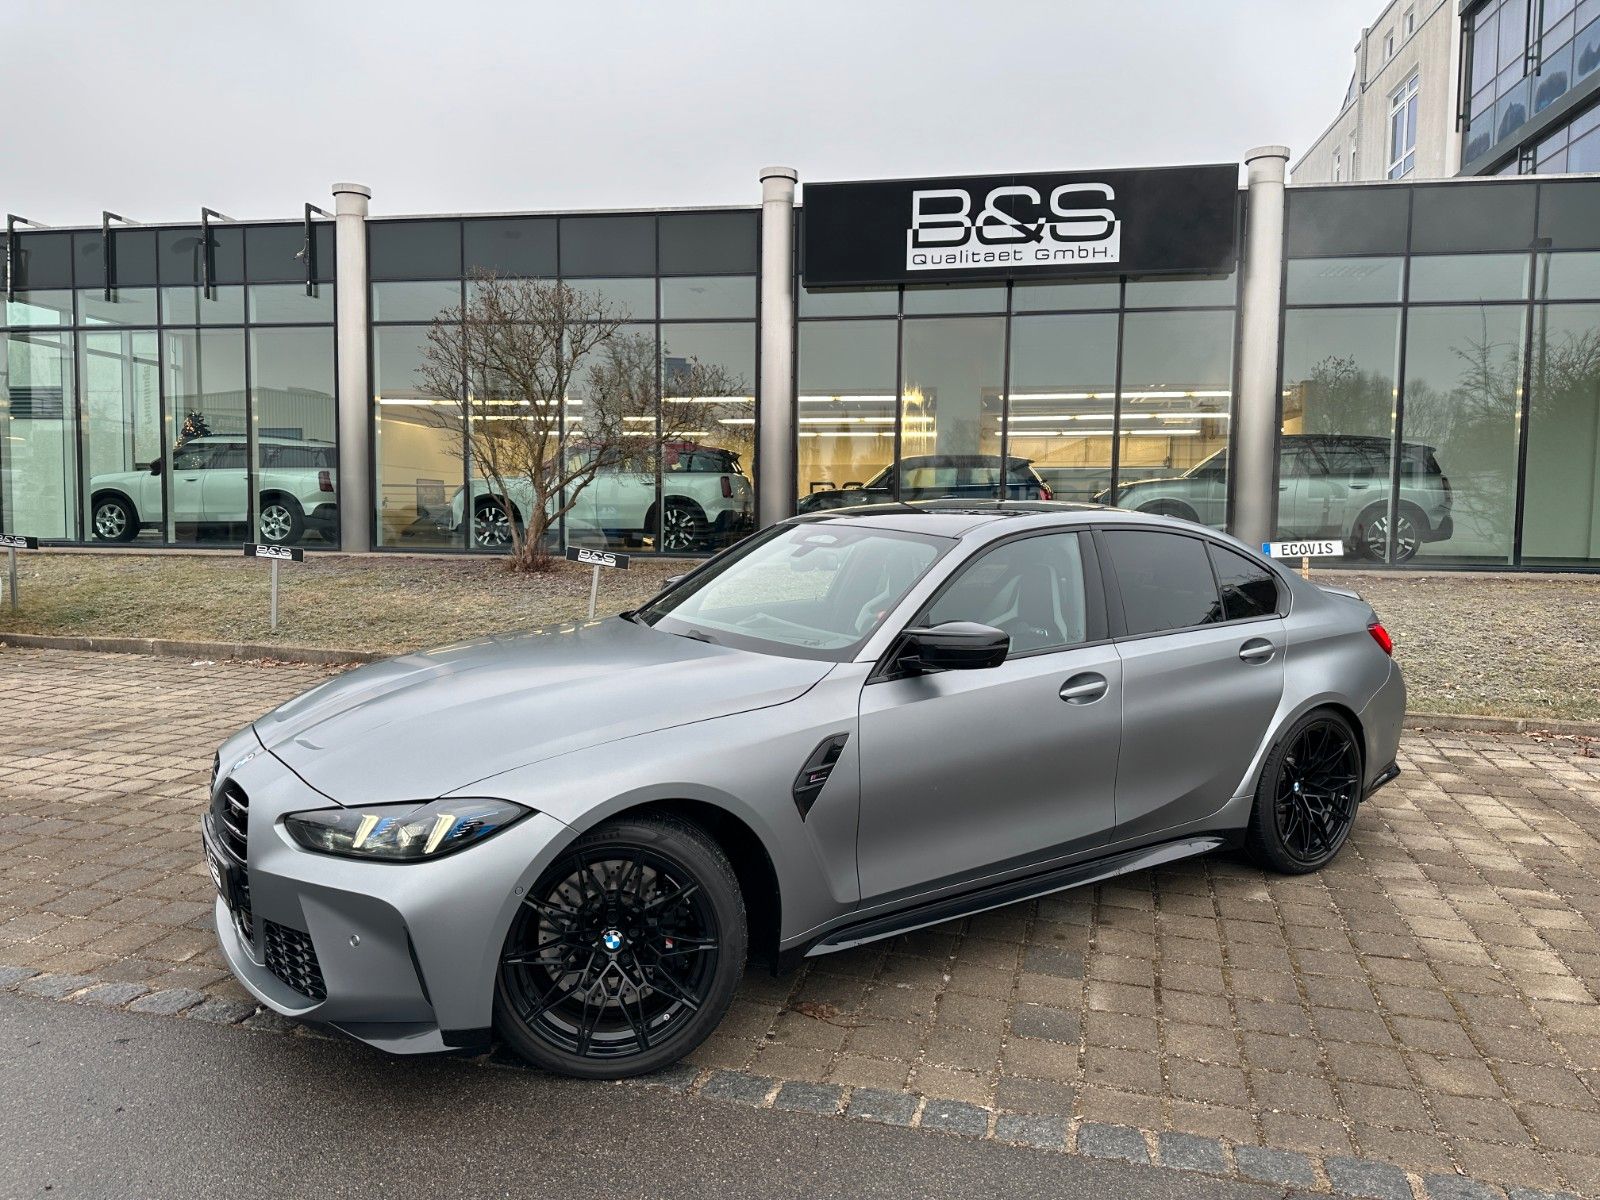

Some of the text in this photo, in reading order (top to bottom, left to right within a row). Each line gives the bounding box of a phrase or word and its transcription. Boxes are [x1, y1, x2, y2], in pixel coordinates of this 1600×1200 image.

[912, 182, 1116, 249] B&S
[912, 245, 1115, 265] Qualitaet GmbH.
[256, 545, 292, 556] B&S
[578, 549, 616, 563] B&S
[1281, 542, 1334, 556] ECOVIS
